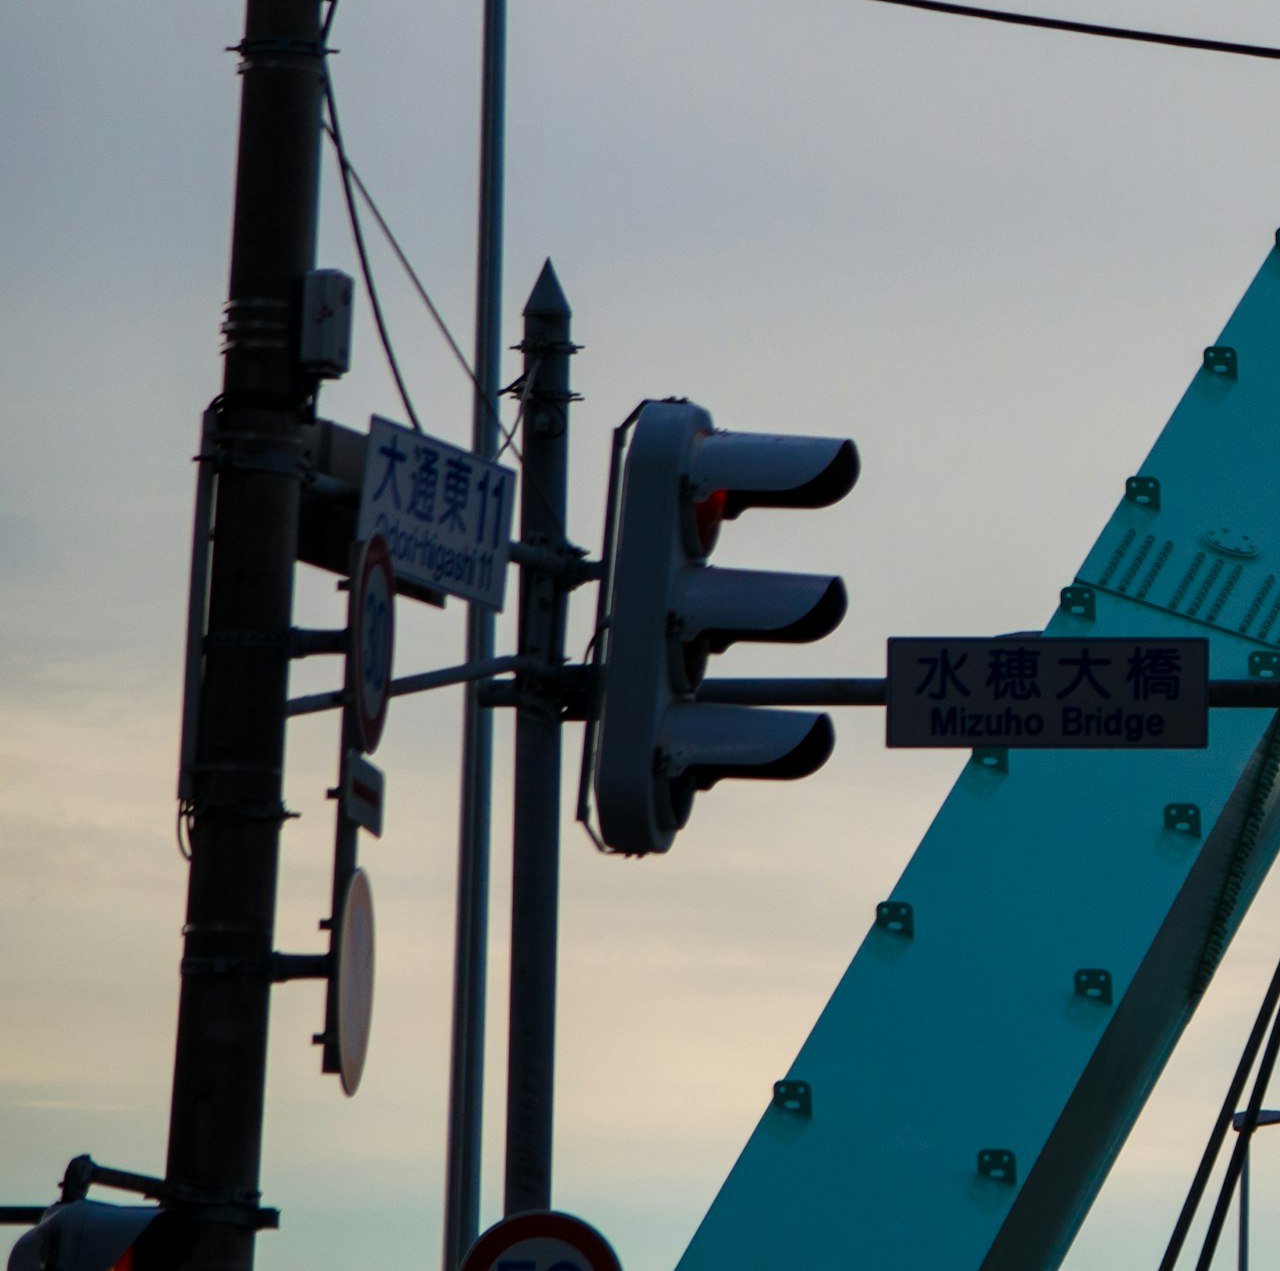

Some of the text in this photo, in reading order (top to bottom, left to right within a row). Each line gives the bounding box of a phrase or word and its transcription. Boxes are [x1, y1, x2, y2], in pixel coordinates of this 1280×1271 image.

[915, 646, 1182, 701] 水穂大橋
[930, 707, 1165, 742] Mizuho Bridge
